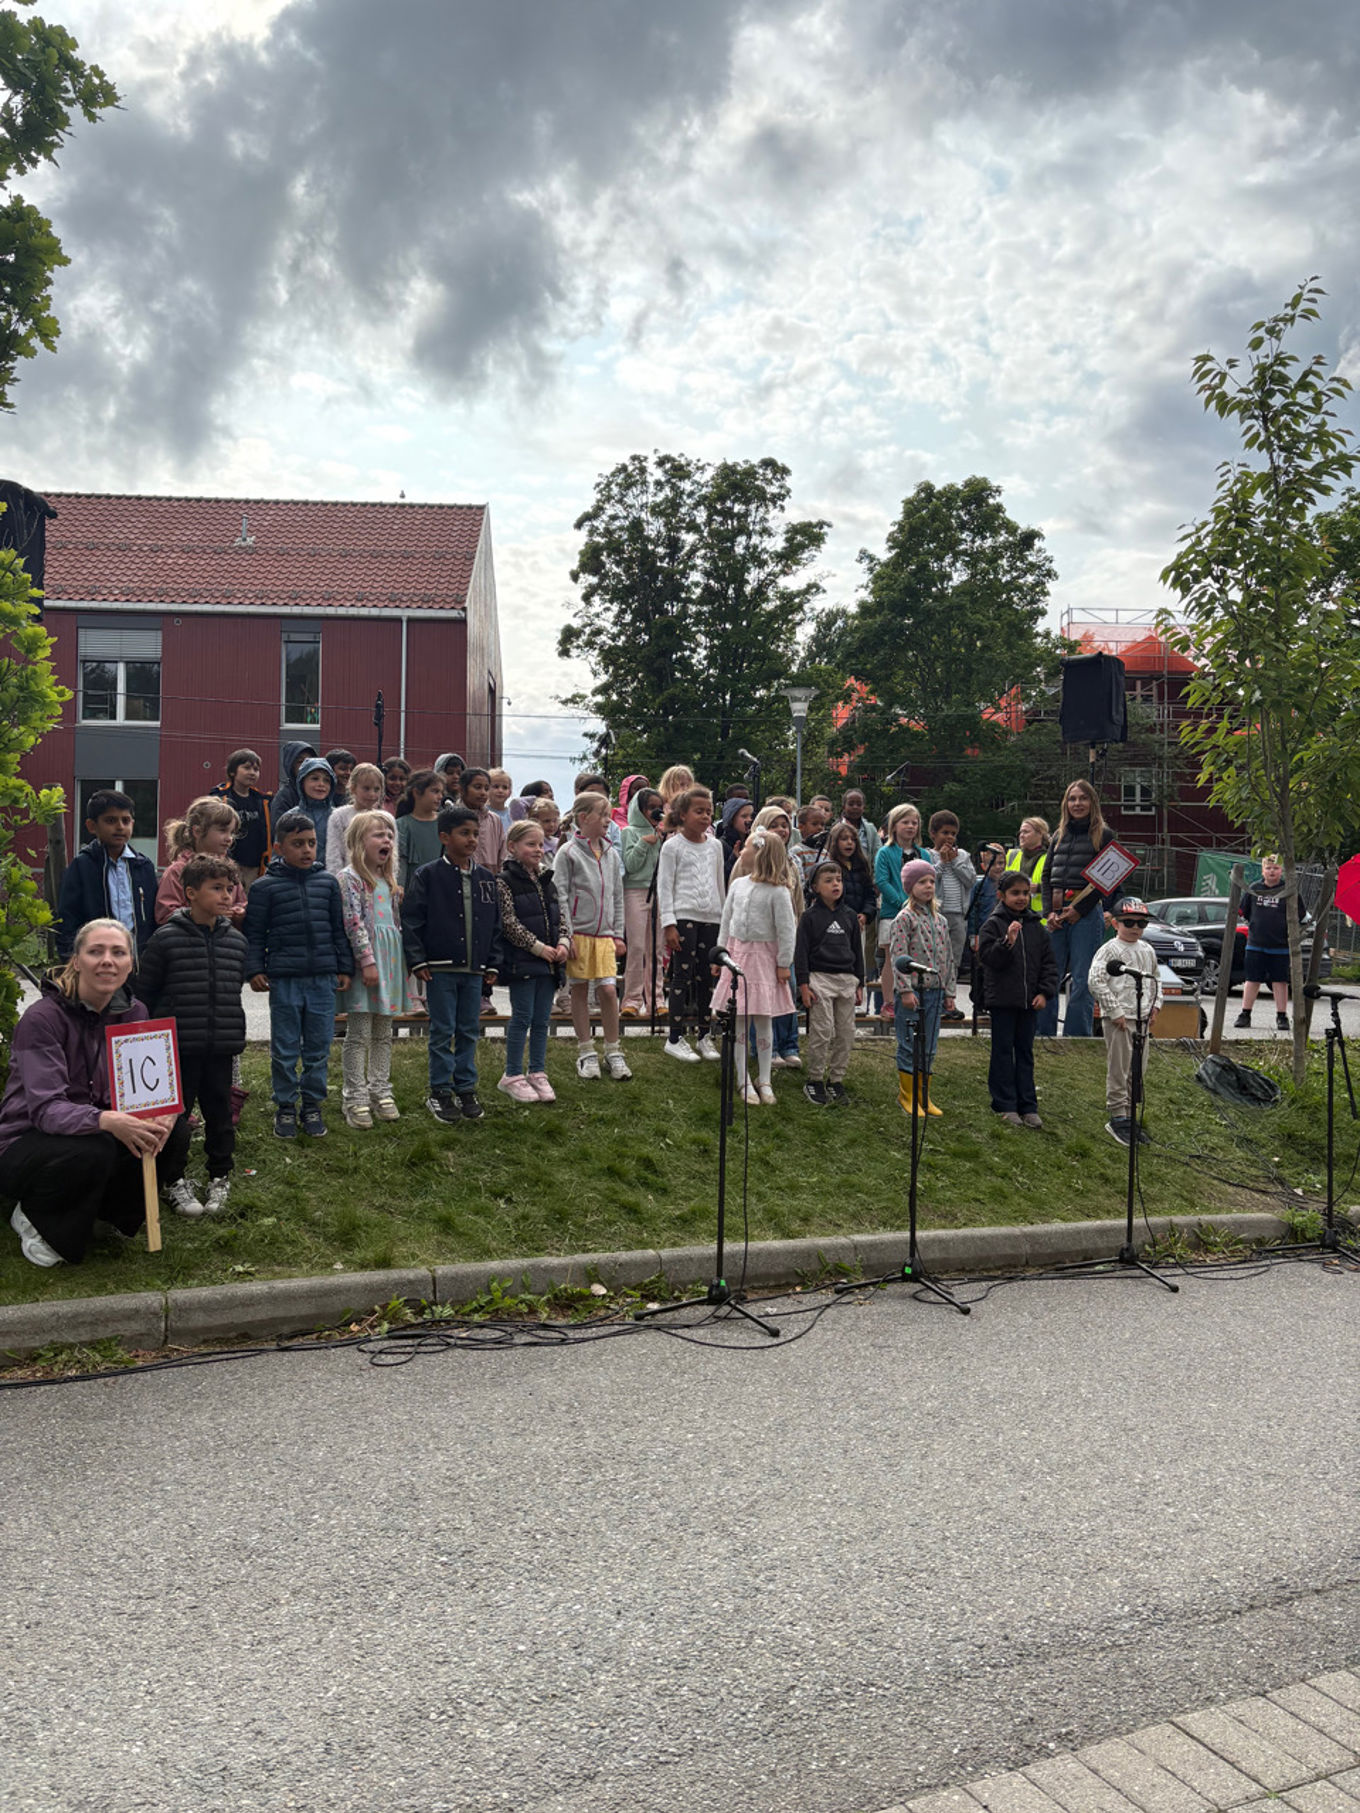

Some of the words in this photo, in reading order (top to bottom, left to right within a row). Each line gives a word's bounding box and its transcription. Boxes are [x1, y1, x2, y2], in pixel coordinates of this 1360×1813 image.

[1097, 858, 1120, 881] 1B
[479, 880, 495, 903] N
[128, 1055, 160, 1094] 1C
